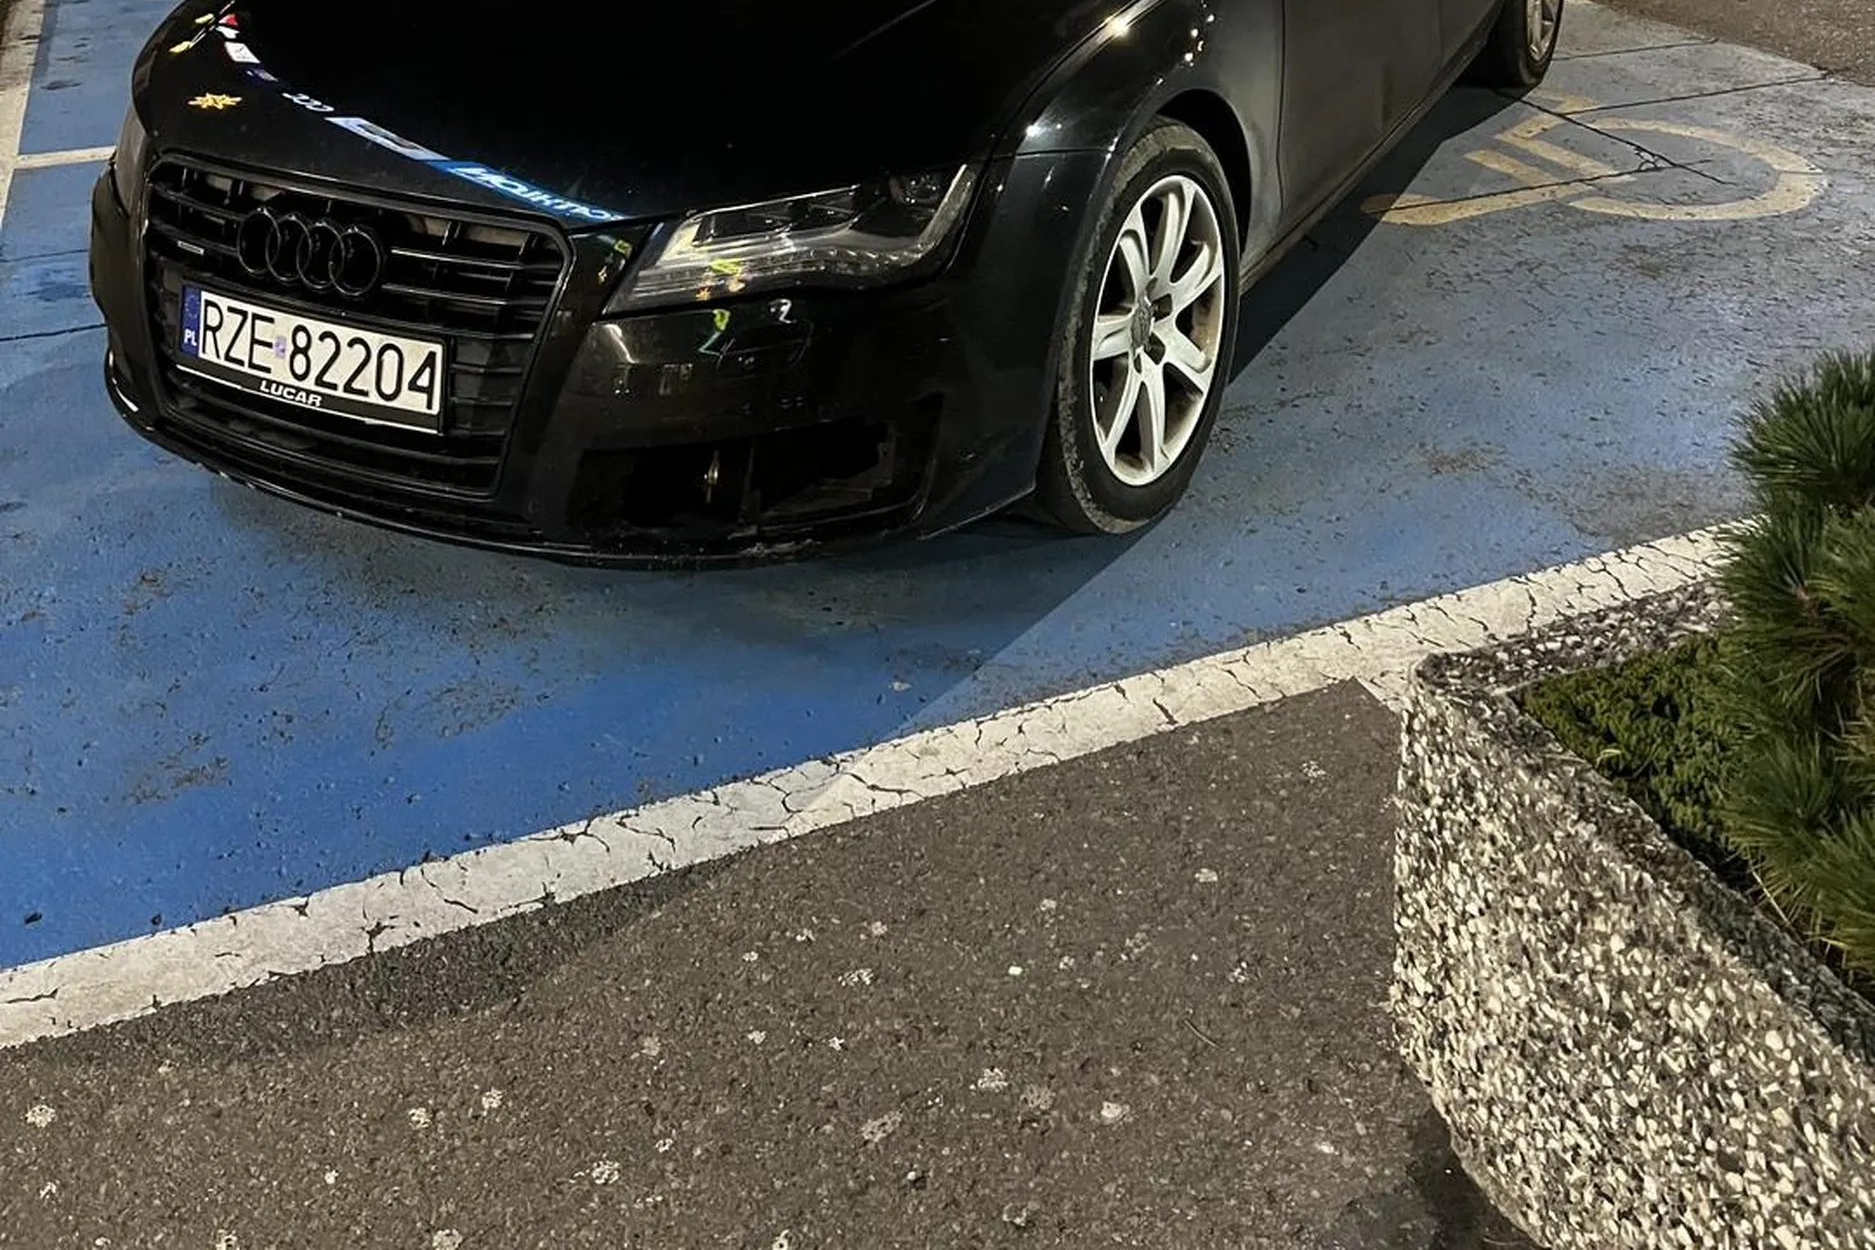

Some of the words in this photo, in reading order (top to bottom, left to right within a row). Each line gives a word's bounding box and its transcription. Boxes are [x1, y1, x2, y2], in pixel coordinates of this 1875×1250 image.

[185, 329, 198, 347] PL
[201, 298, 275, 374] RZE
[289, 324, 438, 411] 82204
[259, 380, 322, 407] LUCAR
